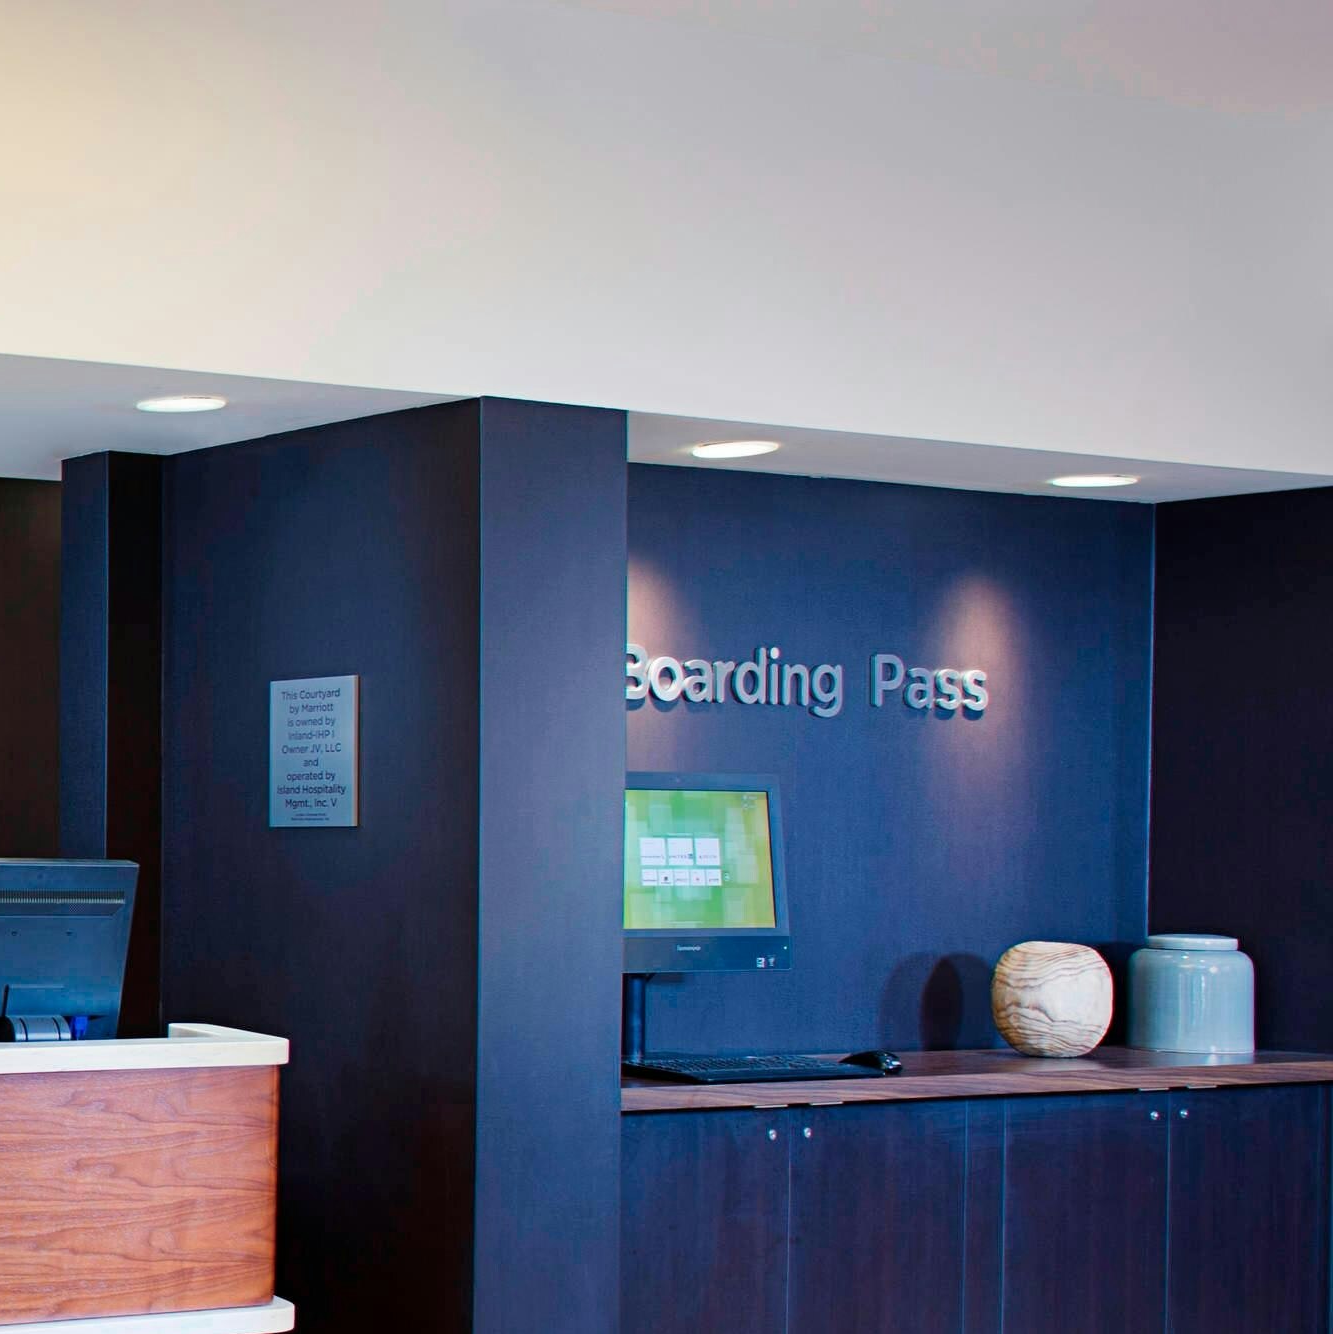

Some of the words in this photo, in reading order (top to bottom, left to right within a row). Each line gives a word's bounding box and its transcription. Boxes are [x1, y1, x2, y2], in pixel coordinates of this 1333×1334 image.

[626, 644, 843, 718] Boarding
[870, 653, 989, 711] Pass
[282, 691, 298, 700] This
[299, 688, 341, 700] Courtyard
[289, 704, 300, 715] by
[301, 703, 334, 713] Marriott
[295, 717, 324, 727] owned
[325, 716, 336, 727] by
[281, 745, 309, 754] Owner
[325, 743, 342, 753] LLC
[303, 758, 319, 767] and
[286, 771, 324, 782] operated
[325, 770, 336, 781] by
[277, 785, 301, 795] Island
[302, 783, 347, 795] Hospitality
